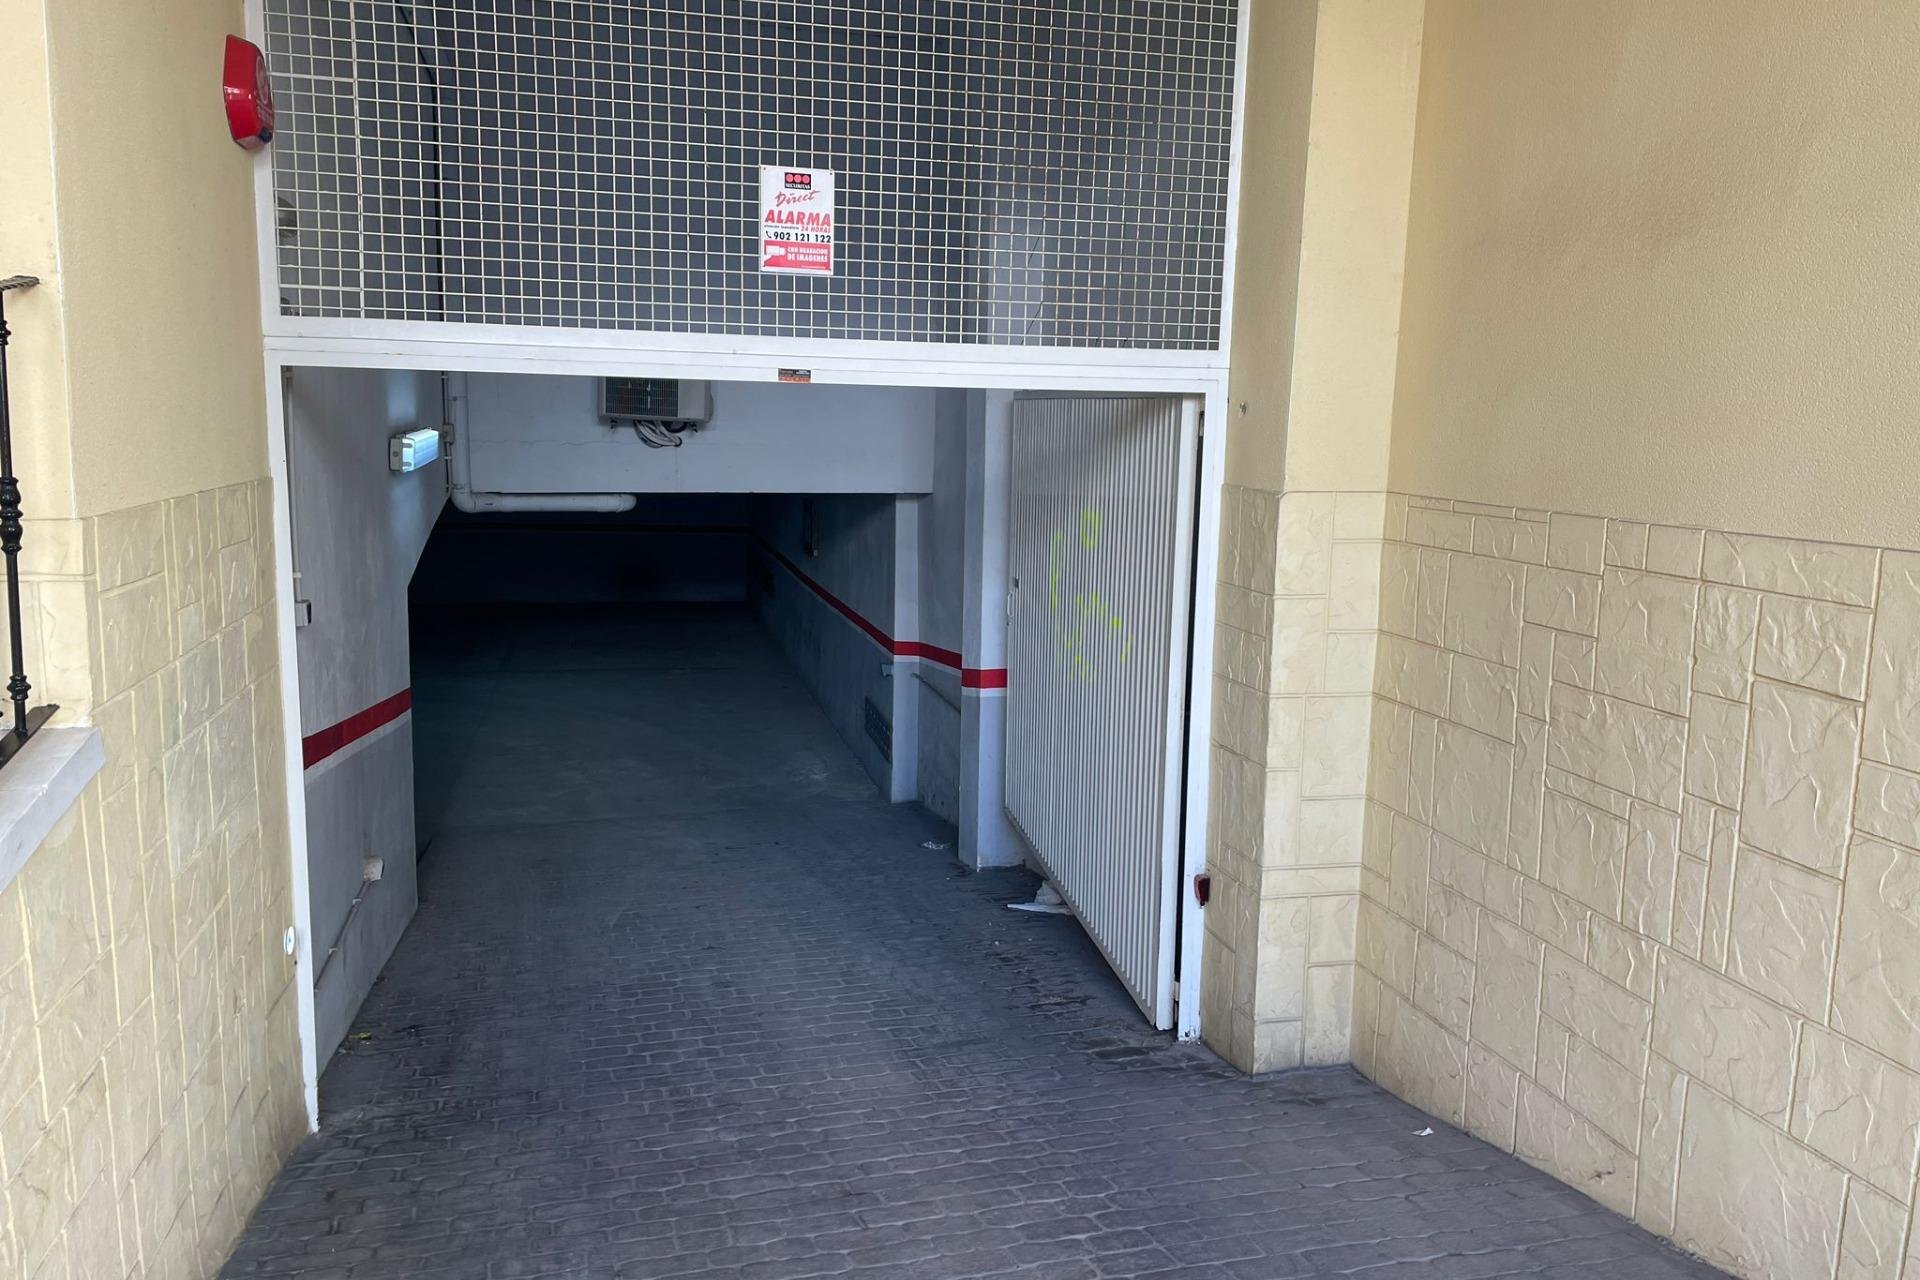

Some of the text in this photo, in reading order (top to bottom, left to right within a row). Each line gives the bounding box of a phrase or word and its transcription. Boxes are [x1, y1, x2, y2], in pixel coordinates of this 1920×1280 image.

[775, 189, 821, 207] Direct
[764, 209, 832, 227] ALARMA
[773, 231, 832, 243] 902 121 122
[787, 253, 797, 261] DE
